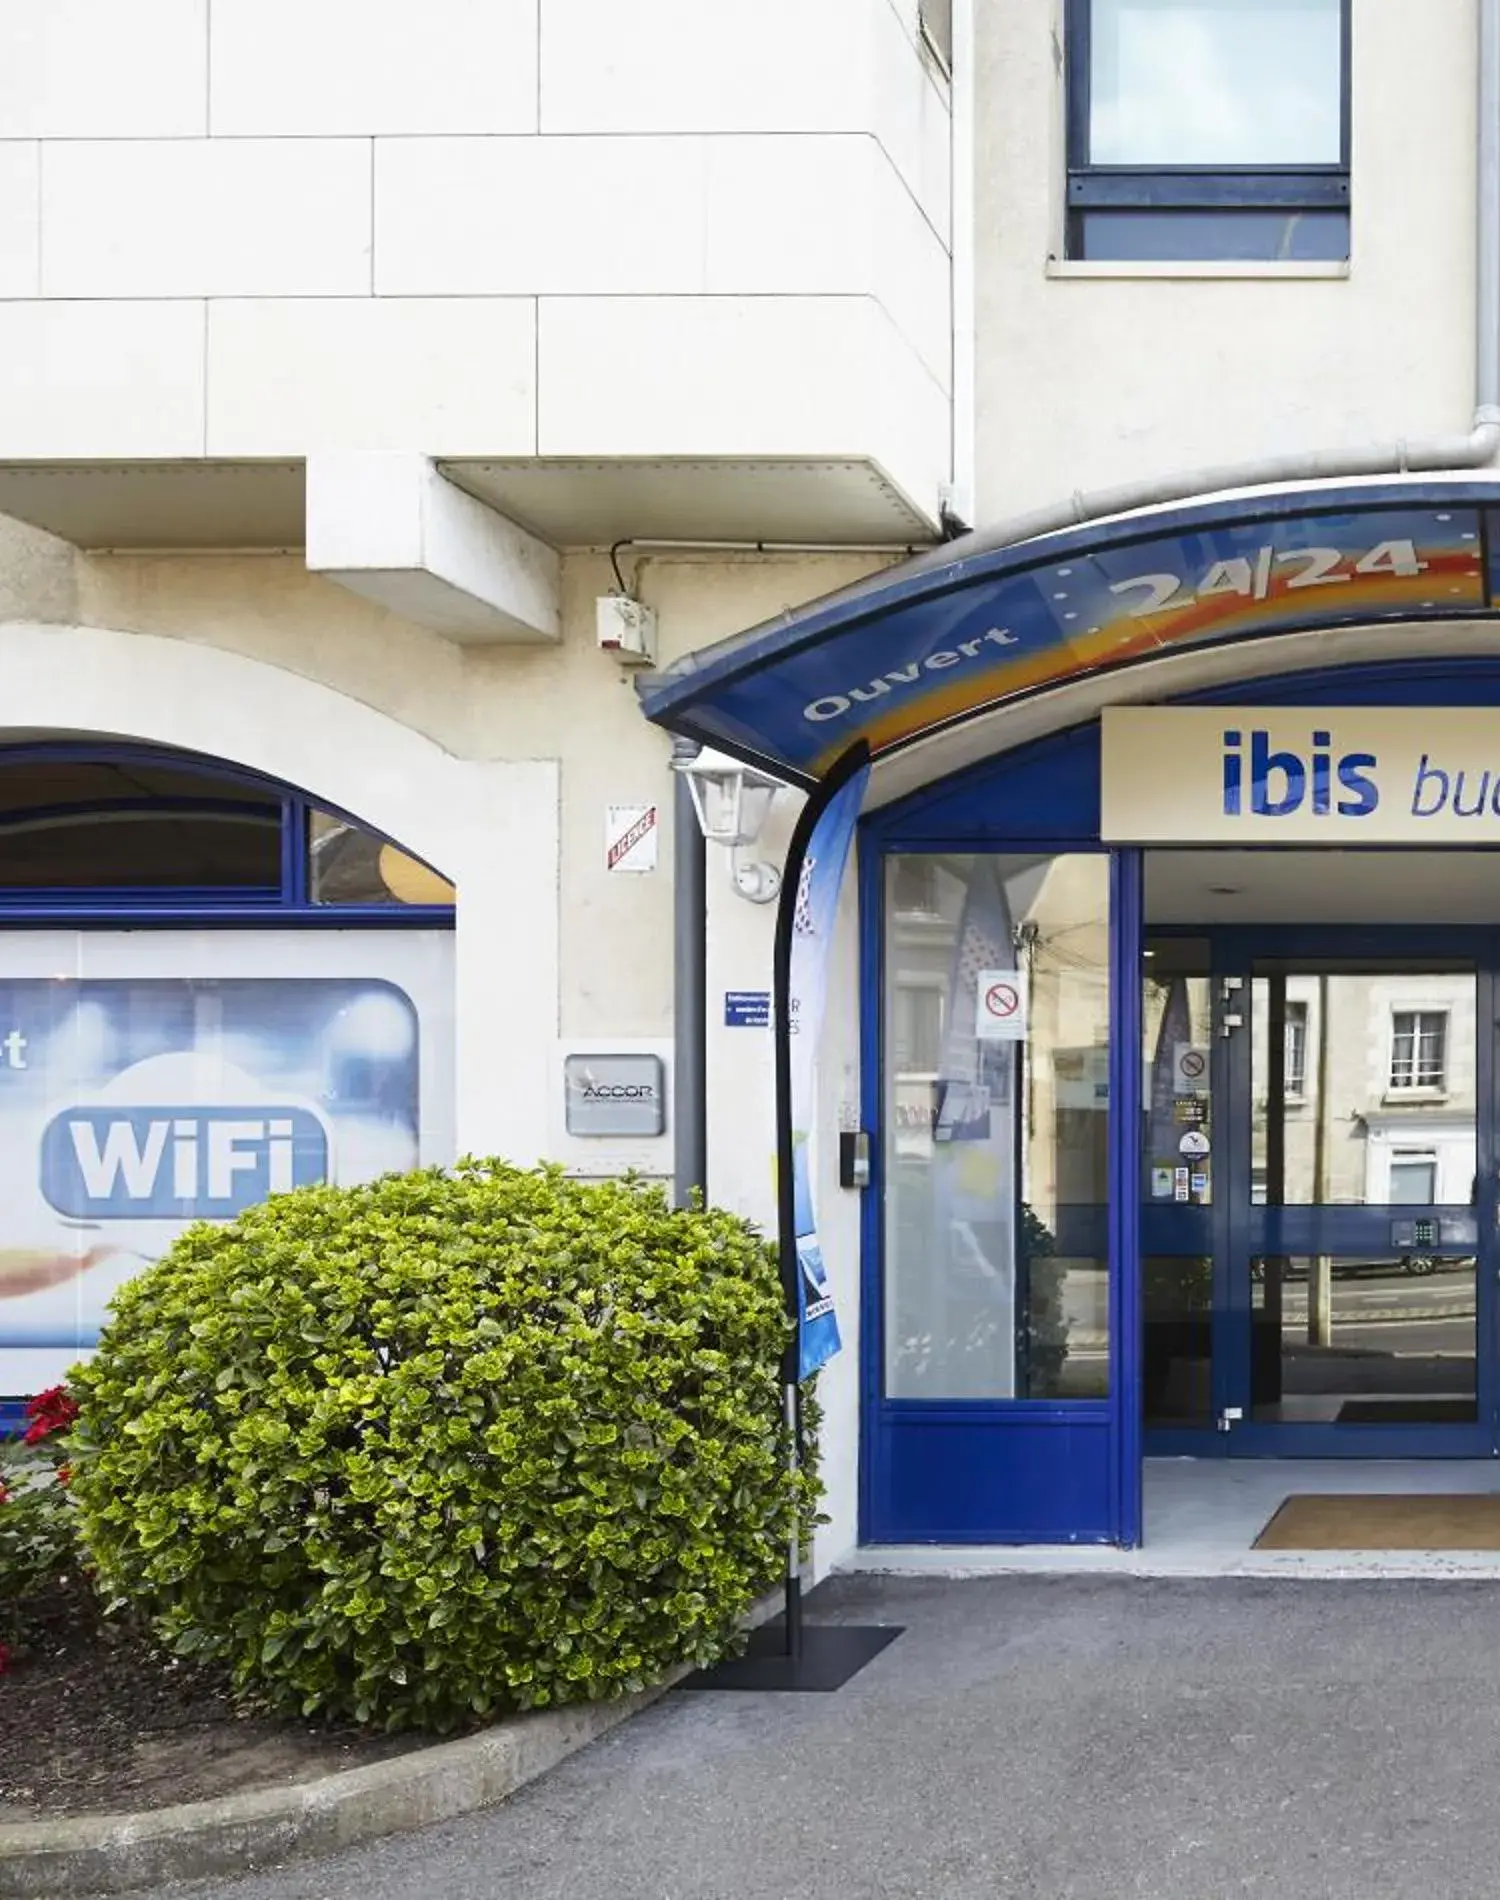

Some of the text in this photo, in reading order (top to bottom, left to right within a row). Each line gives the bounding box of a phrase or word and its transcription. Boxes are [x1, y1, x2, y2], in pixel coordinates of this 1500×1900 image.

[803, 539, 1429, 725] Ouvert 24/24
[1222, 730, 1380, 816] ibis
[583, 1085, 654, 1097] ACCOR
[69, 1119, 293, 1199] WiFi
